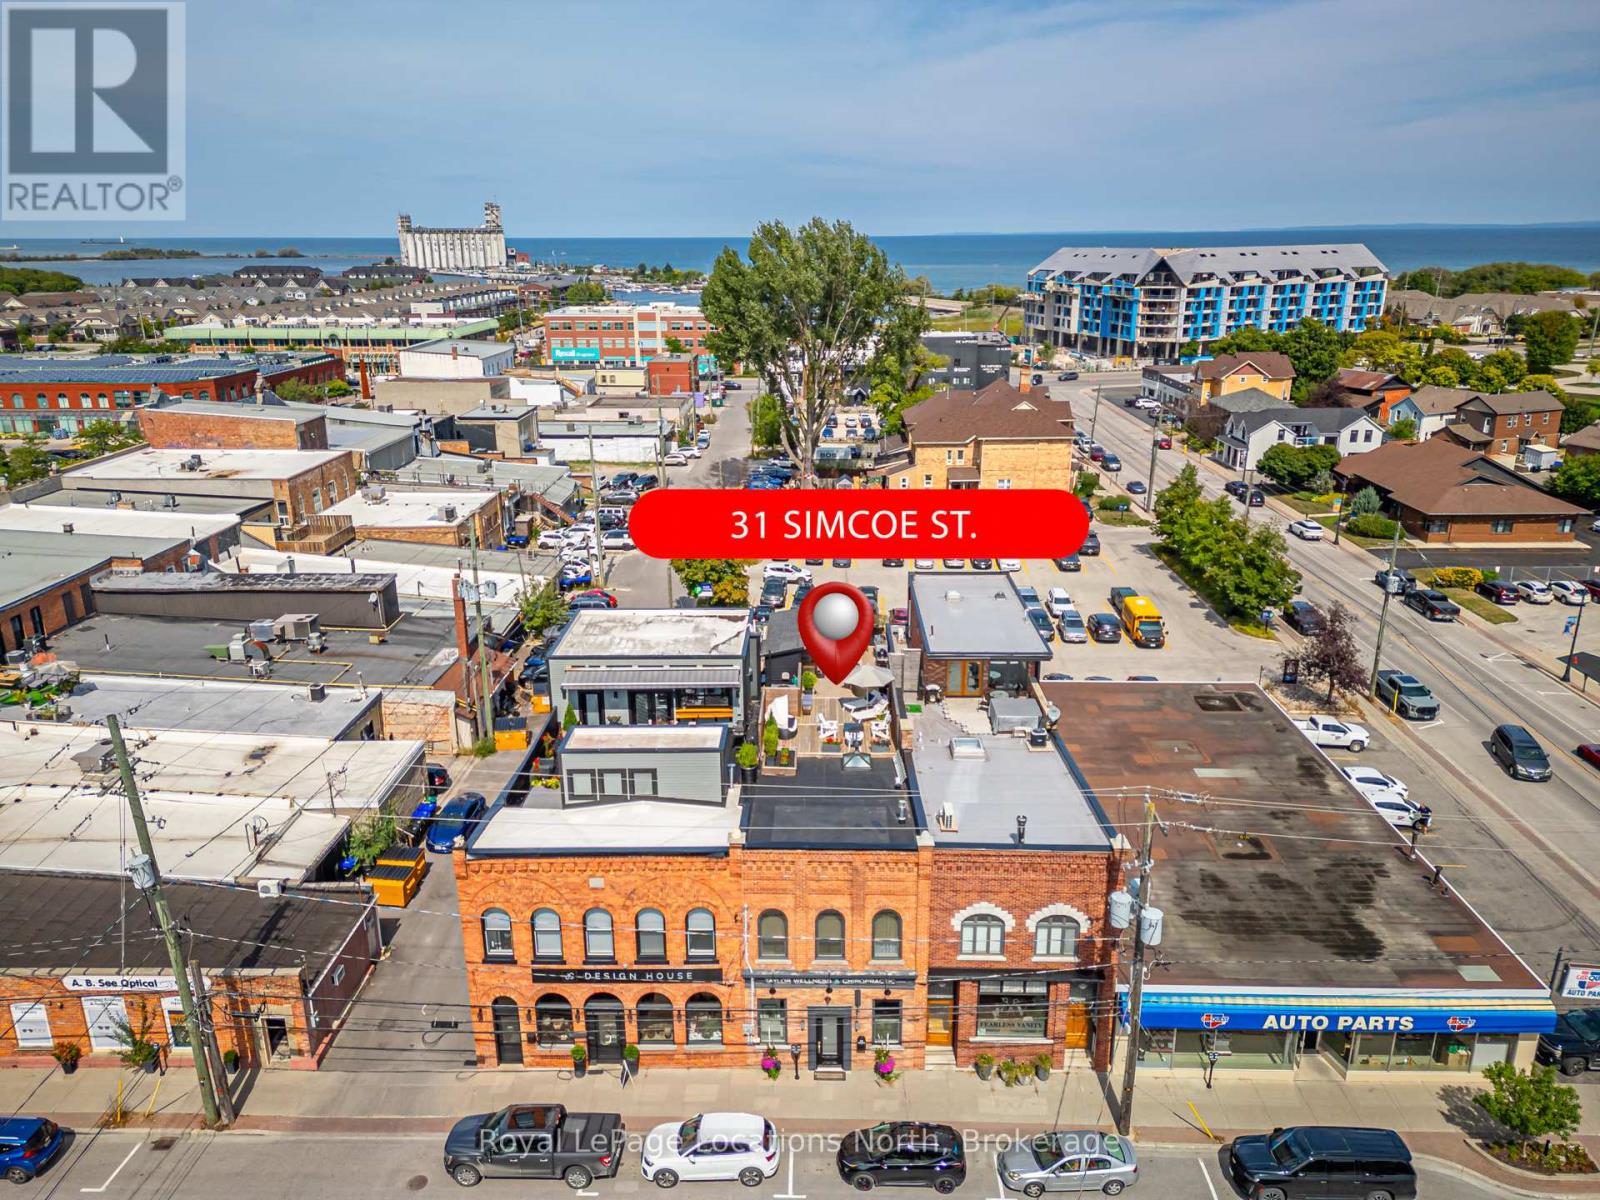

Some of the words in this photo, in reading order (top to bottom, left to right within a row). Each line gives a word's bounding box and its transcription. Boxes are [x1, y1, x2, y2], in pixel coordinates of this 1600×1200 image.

[584, 971, 637, 980] DESIGN
[646, 972, 693, 980] HOUSE
[71, 979, 82, 987] A.
[86, 979, 95, 987] B.
[99, 979, 117, 987] See
[121, 979, 158, 989] Optical
[1016, 1020, 1042, 1029] VANITY
[1262, 1014, 1328, 1030] AUTO
[1337, 1015, 1414, 1031] PARTS
